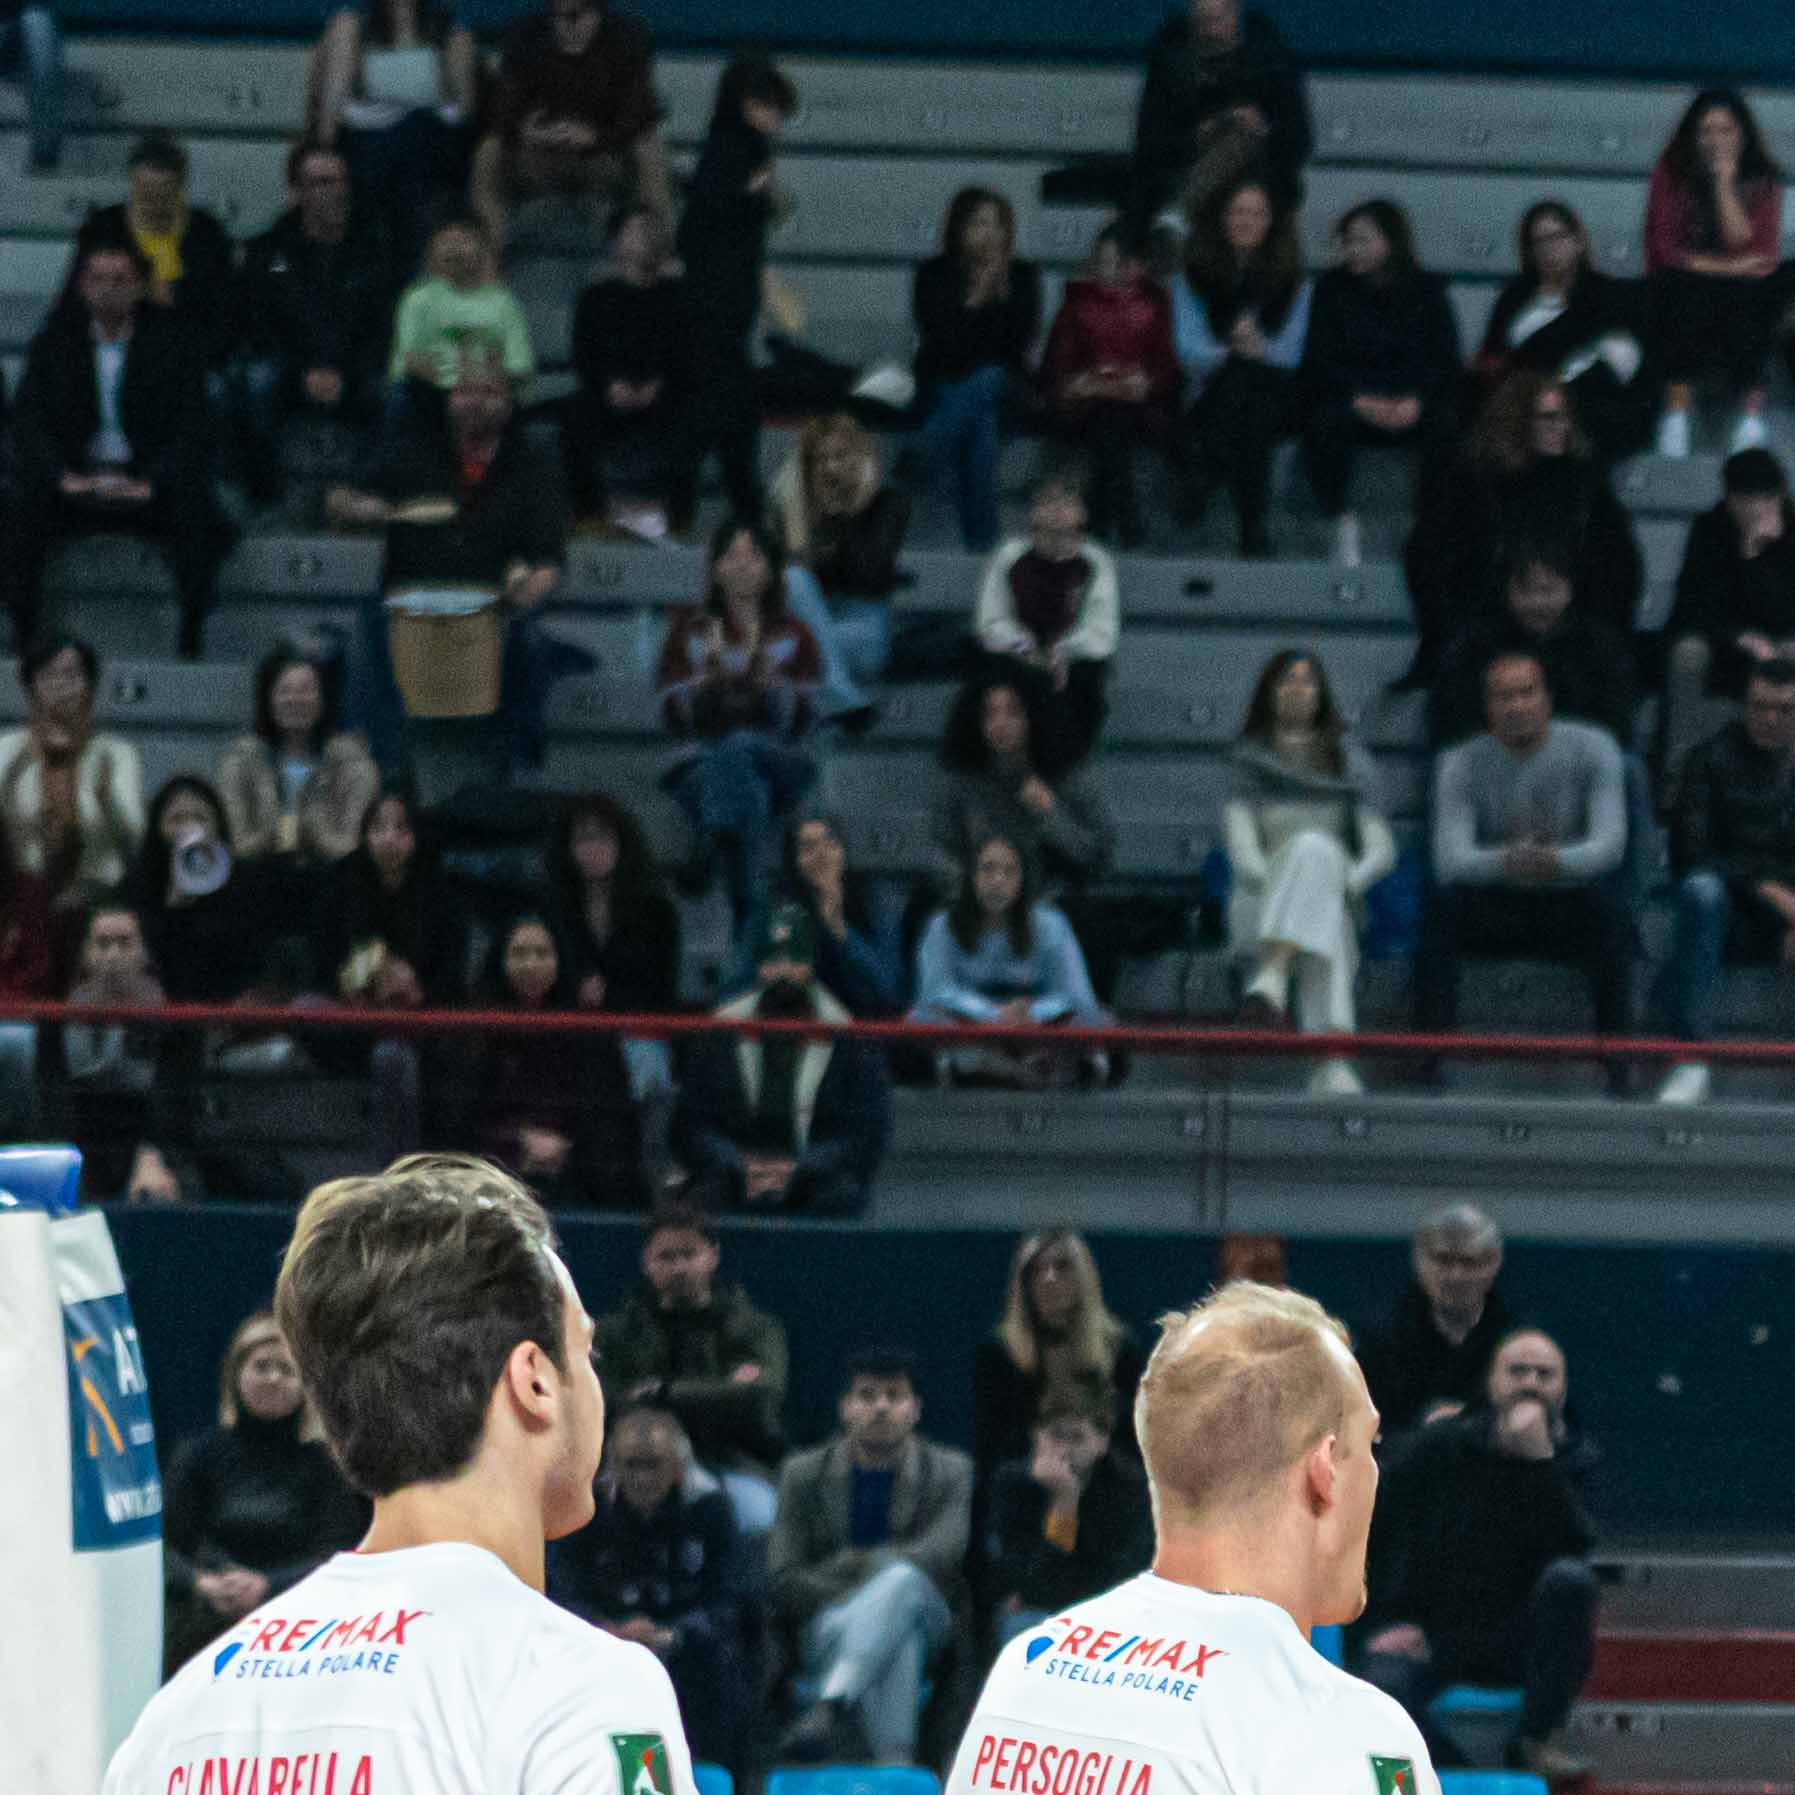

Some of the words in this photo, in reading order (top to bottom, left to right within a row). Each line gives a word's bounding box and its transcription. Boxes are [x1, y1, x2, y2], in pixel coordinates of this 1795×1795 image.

[248, 1608, 425, 1652] RE/MAX
[1057, 1624, 1224, 1679] RE/MAX
[236, 1656, 310, 1679] STELLA
[318, 1652, 400, 1676] POLARE
[1045, 1656, 1116, 1687] STELLA
[1120, 1672, 1199, 1702] POLARE
